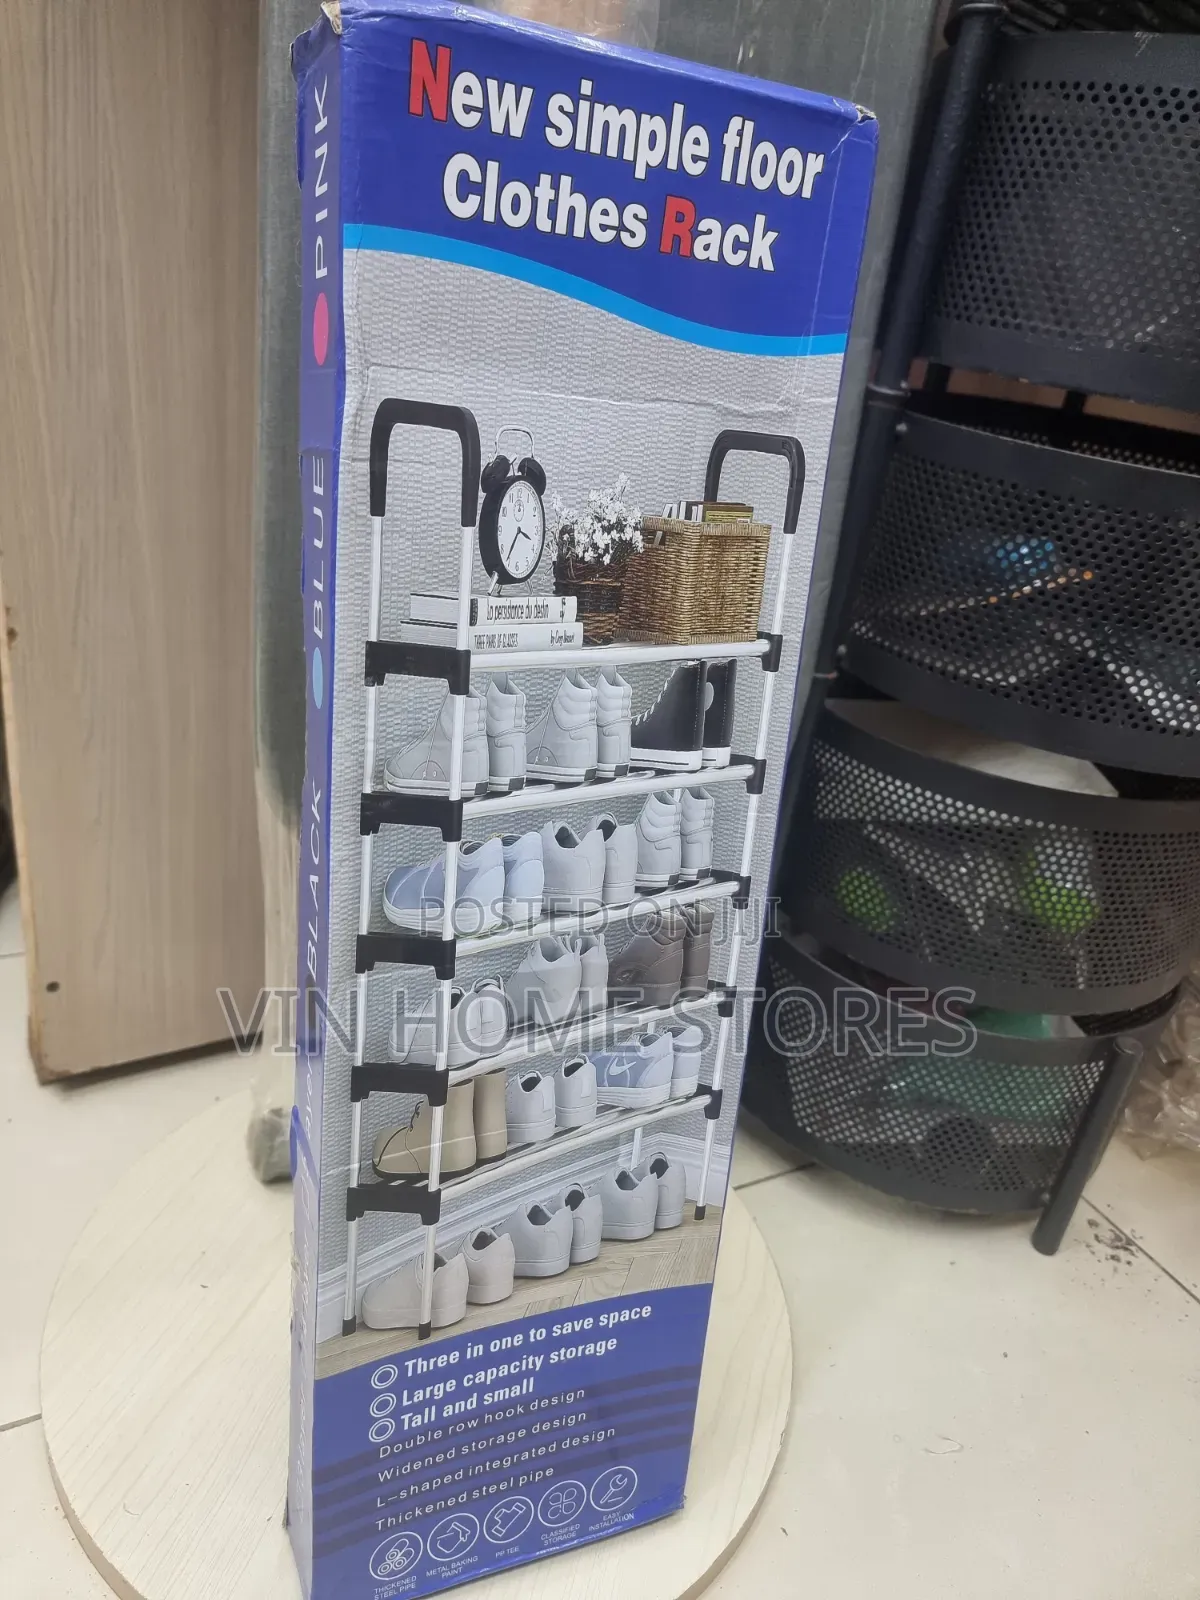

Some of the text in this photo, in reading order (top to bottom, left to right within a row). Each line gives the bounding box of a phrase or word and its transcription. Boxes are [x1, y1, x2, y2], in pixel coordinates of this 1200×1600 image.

[408, 38, 824, 199] New simple floor
[315, 75, 328, 280] PINK
[442, 152, 778, 272] Clothes Rack
[312, 455, 324, 640] BLUE
[307, 777, 321, 983] BLACK
[404, 1305, 652, 1377] Three in one to save space
[402, 1337, 618, 1406] Large capacity storage
[379, 1388, 585, 1459] Double row hook design
[401, 1377, 534, 1431] Tall and small
[378, 1411, 587, 1483] Widened storage design
[469, 1441, 556, 1476] integrated
[561, 1427, 616, 1449] design
[376, 1467, 554, 1531] Thickened steel pipe
[589, 1513, 635, 1531] INSTALLATION
[603, 1511, 621, 1521] EASY
[540, 1523, 580, 1540] CLASSIFIED
[543, 1531, 577, 1546] STORAGE
[374, 1576, 417, 1594] THICKENED
[374, 1583, 416, 1600] STEEL PIPE
[426, 1556, 478, 1577] METAL BAKING
[441, 1567, 463, 1579] PAINT
